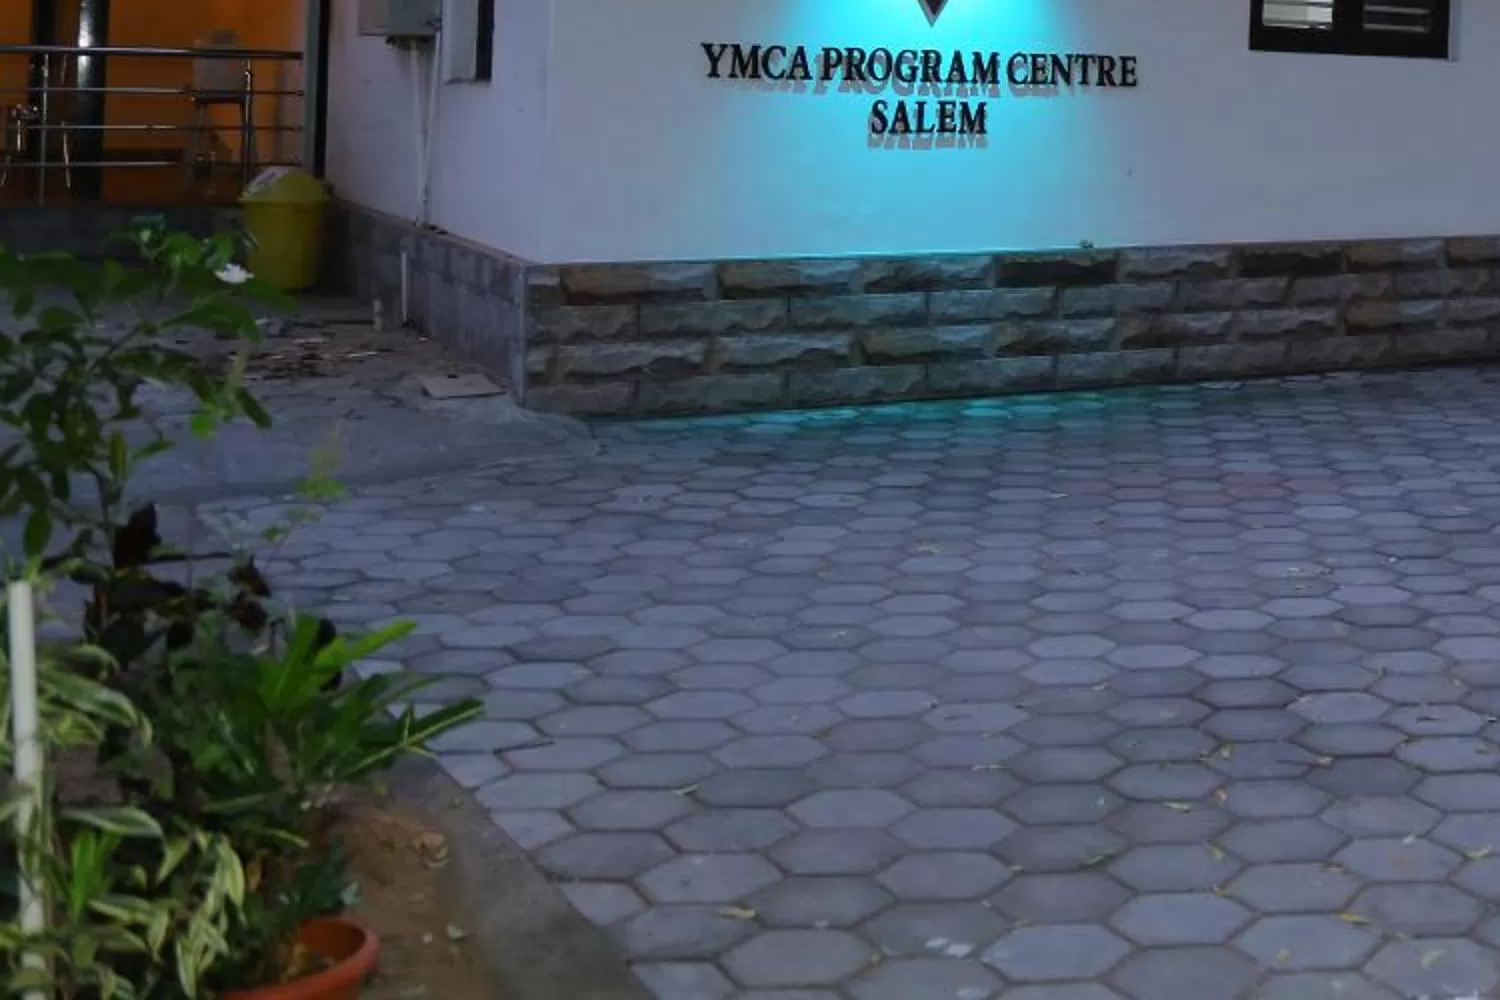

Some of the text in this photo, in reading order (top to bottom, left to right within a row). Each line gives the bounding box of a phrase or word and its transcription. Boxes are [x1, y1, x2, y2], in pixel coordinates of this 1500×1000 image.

[701, 43, 1138, 87] YMCA PROGRAM CENTRE
[871, 100, 988, 135] SALEM
